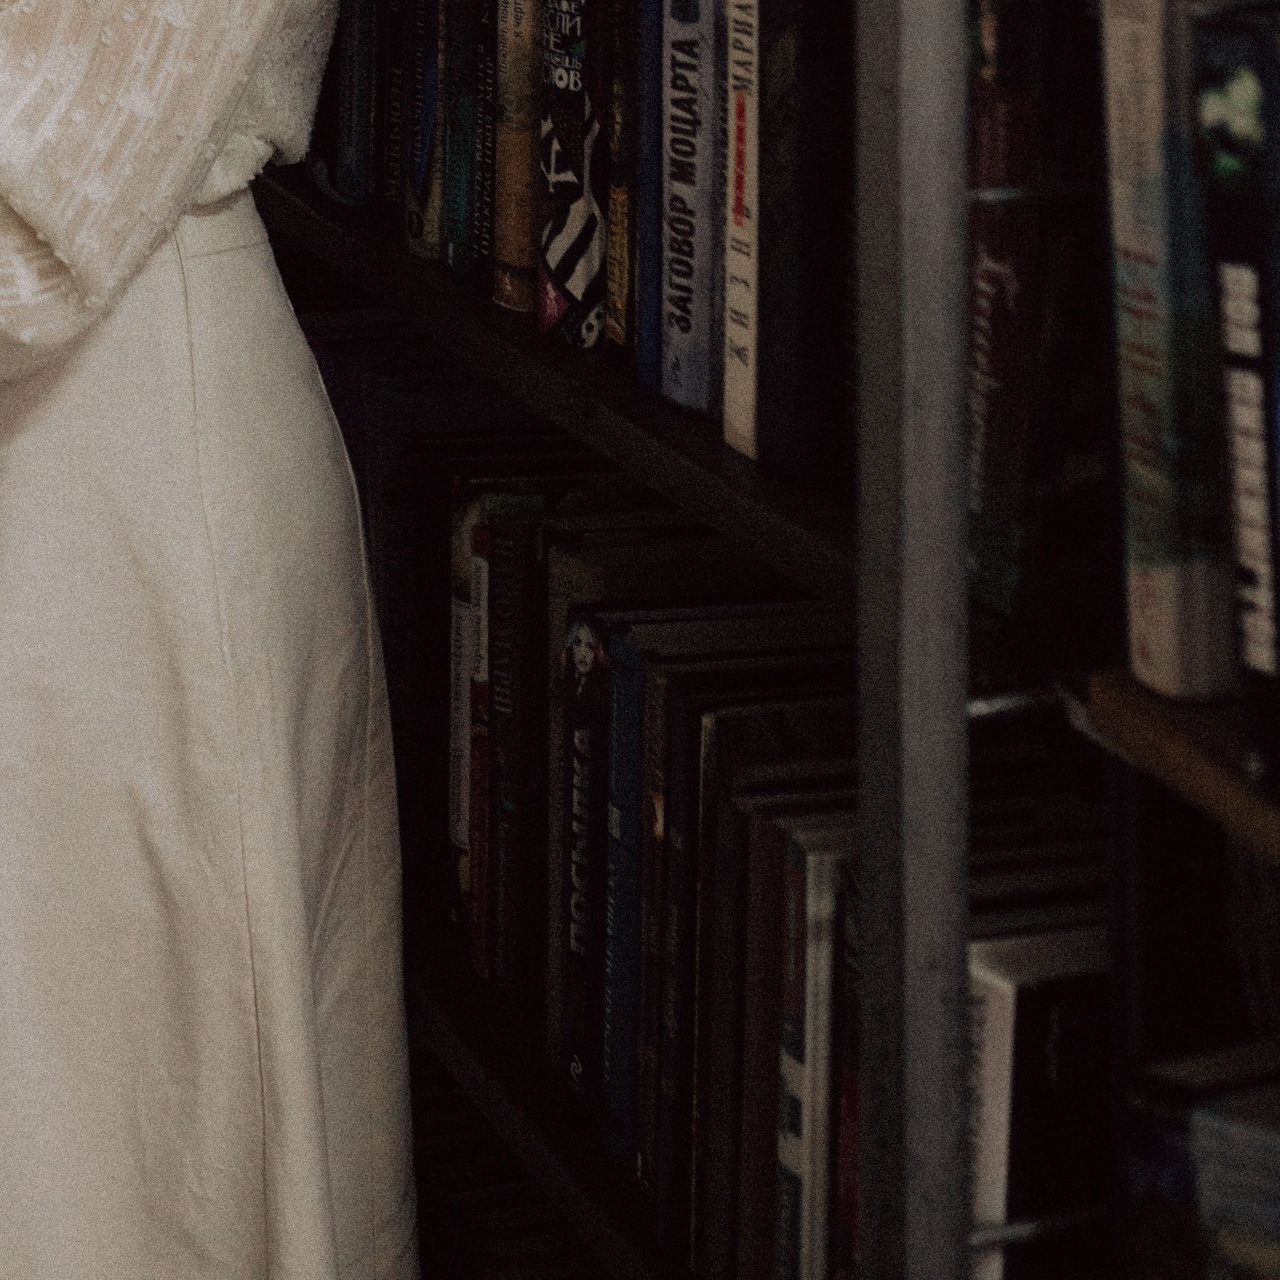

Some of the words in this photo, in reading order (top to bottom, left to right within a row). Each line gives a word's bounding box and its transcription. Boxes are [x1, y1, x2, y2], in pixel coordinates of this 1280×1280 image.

[670, 38, 701, 188] МОЦАРТА
[667, 193, 697, 336] ЗАГОВОР
[568, 726, 593, 955] ПОСЫЛКА
